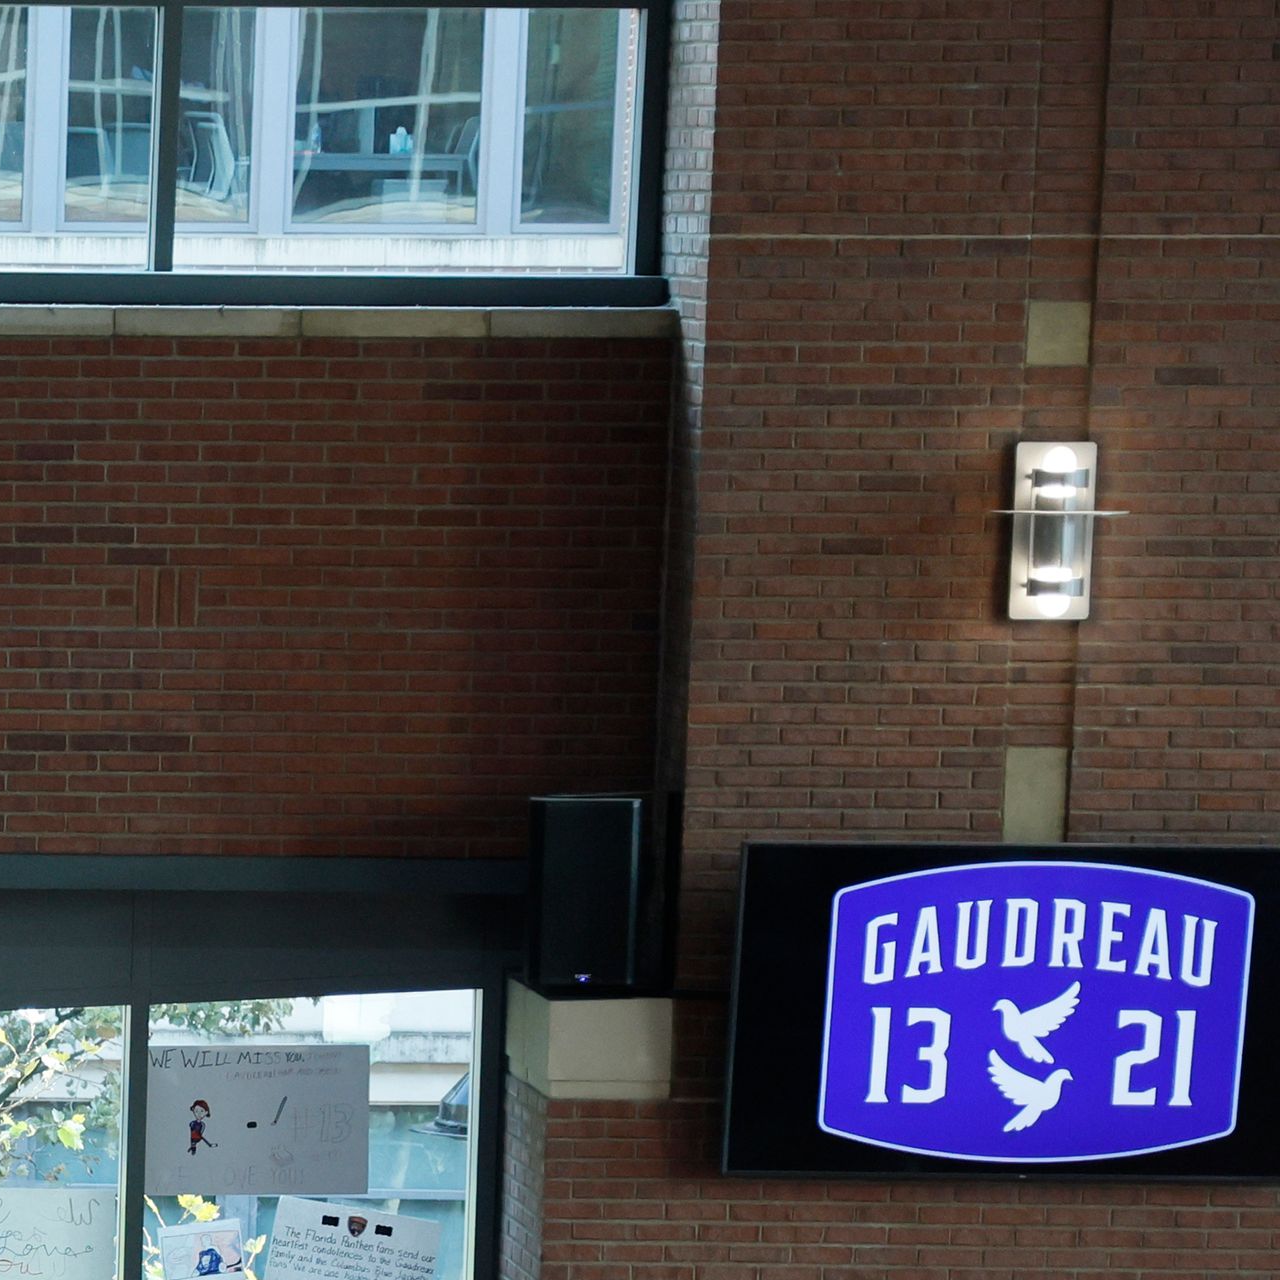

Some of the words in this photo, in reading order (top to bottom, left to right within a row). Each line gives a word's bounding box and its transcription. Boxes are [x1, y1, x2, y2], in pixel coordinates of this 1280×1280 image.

[862, 898, 1218, 988] GAUDREAU
[148, 1048, 177, 1069] WE
[181, 1049, 231, 1068] WILL
[237, 1051, 281, 1065] MISS
[864, 1006, 952, 1104] 13
[1111, 1009, 1197, 1107] 21
[284, 1226, 301, 1239] The
[304, 1229, 337, 1245] Florida
[376, 1242, 395, 1256] fans
[397, 1249, 419, 1261] send
[311, 1244, 364, 1261] condolences
[297, 1253, 313, 1264] and
